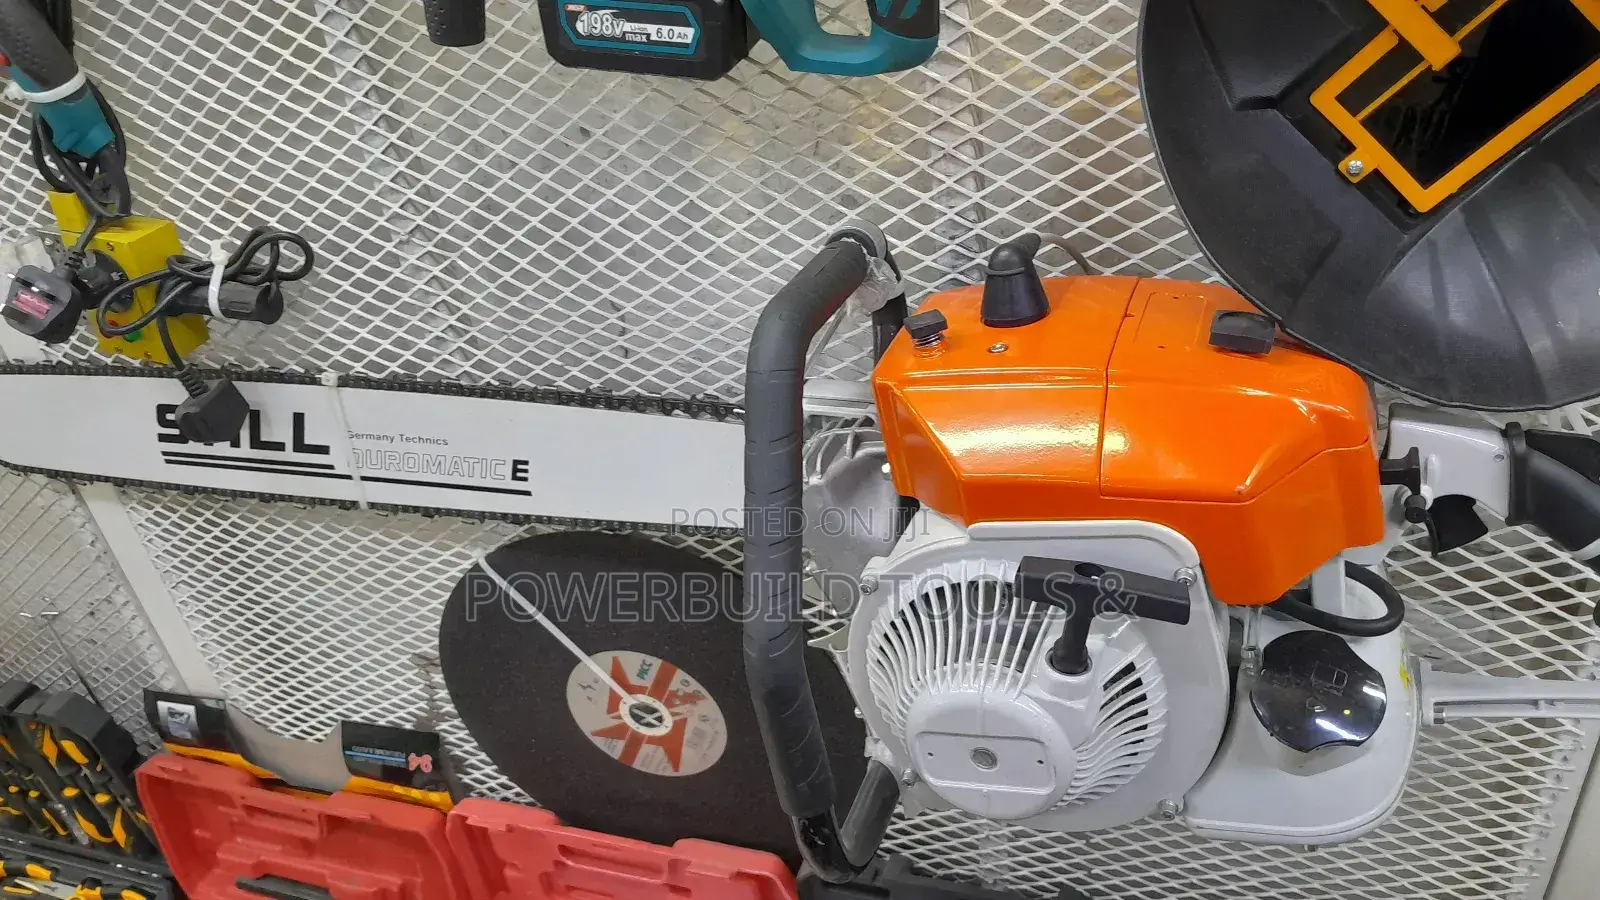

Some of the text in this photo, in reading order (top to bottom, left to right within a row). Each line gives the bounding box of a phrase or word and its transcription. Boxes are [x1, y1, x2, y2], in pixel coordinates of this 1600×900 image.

[624, 33, 648, 43] max
[656, 27, 675, 40] 6.0
[676, 32, 689, 41] Ah
[156, 403, 331, 455] SLL
[399, 433, 449, 446] Technics
